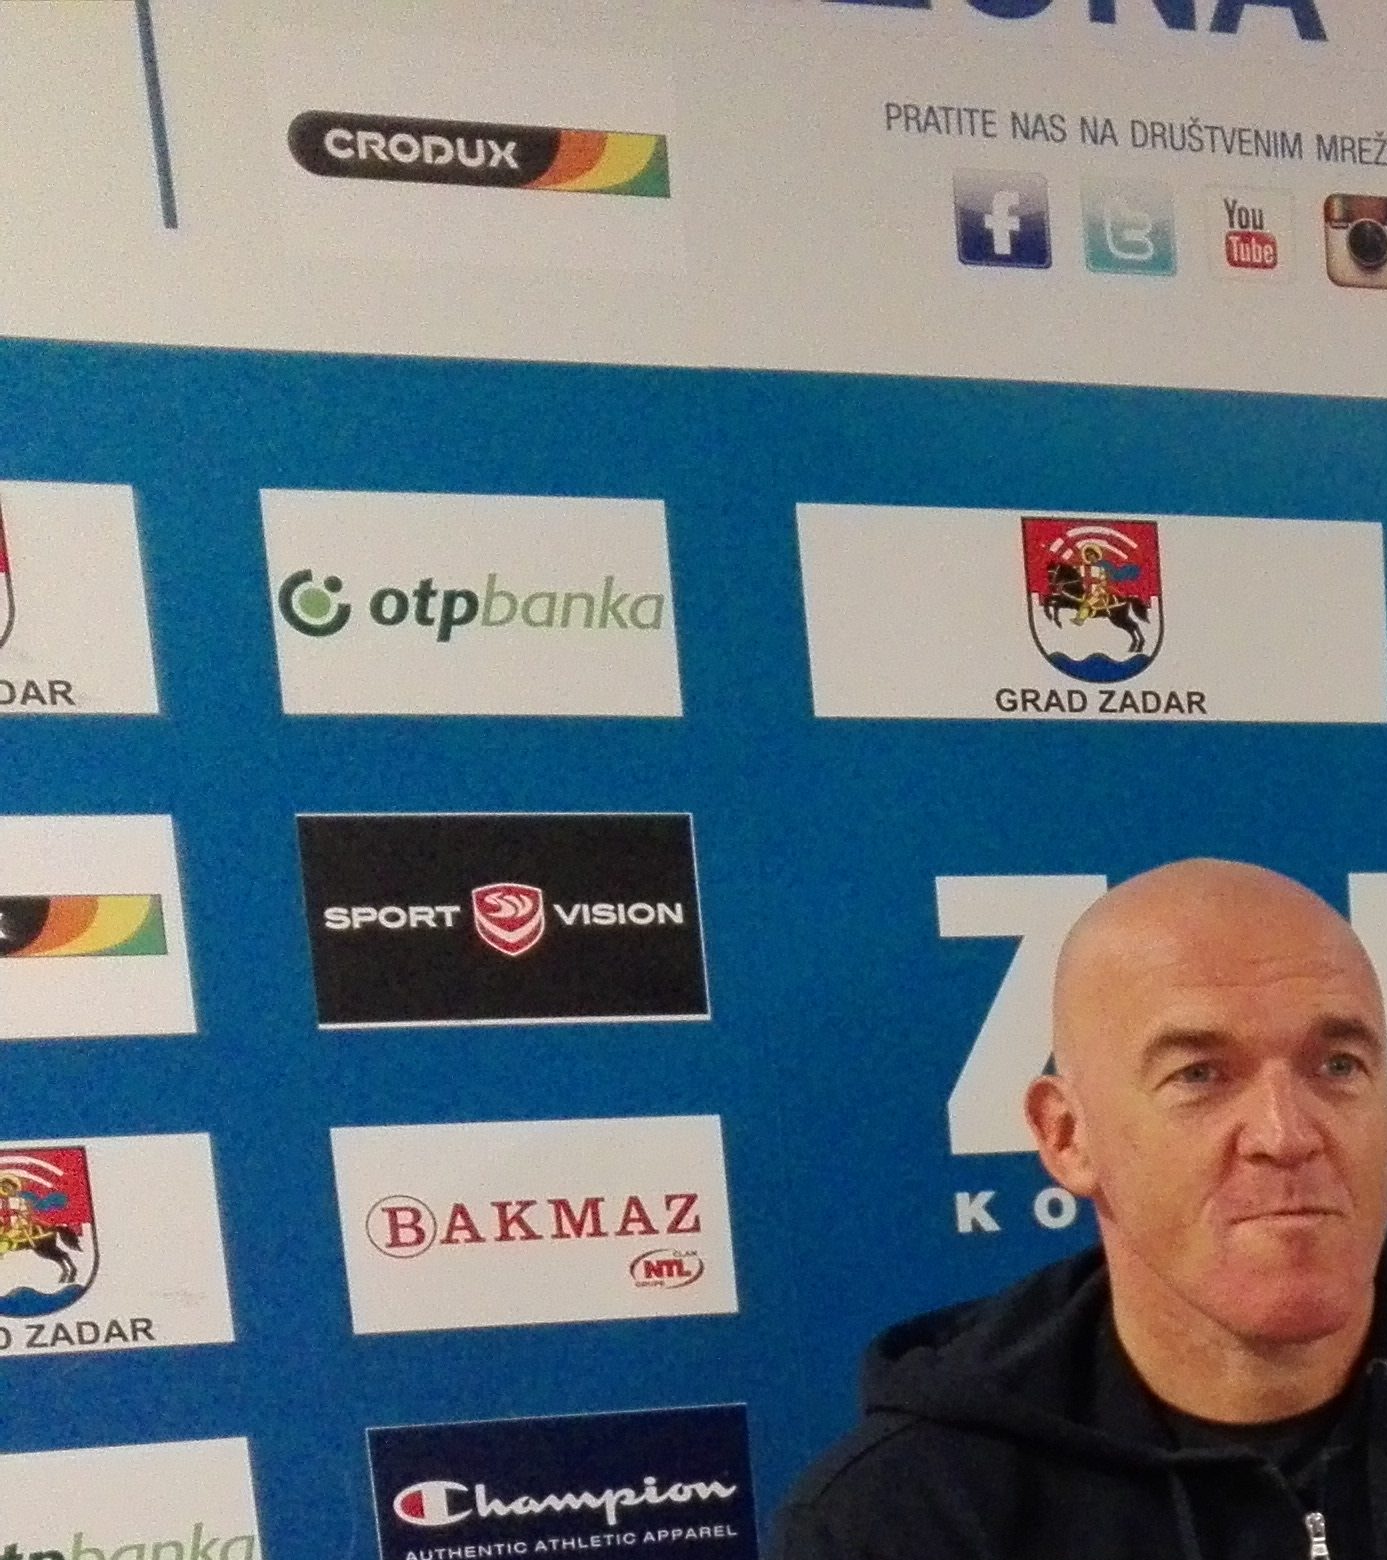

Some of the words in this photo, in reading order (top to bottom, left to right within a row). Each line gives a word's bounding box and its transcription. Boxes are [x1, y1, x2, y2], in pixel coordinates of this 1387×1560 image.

[884, 103, 998, 139] PRATITE
[1011, 110, 1068, 143] NAS
[1080, 116, 1119, 148] NA
[1130, 115, 1303, 162] DRUŠTVENIM
[324, 128, 520, 170] CRODUX
[1225, 199, 1264, 231] You
[1227, 234, 1278, 266] Tube
[370, 573, 665, 642] otpbanka
[995, 688, 1088, 714] GRAD
[1097, 690, 1208, 715] ZADAR
[324, 905, 461, 931] SPORT
[553, 902, 684, 927] VISION
[382, 1194, 701, 1248] BAKMAZ
[643, 1259, 692, 1278] NTL
[25, 1318, 155, 1348] ZADAR
[394, 1476, 737, 1527] Champion
[535, 1533, 636, 1553] ATHLETIC
[644, 1526, 738, 1544] APPAREL
